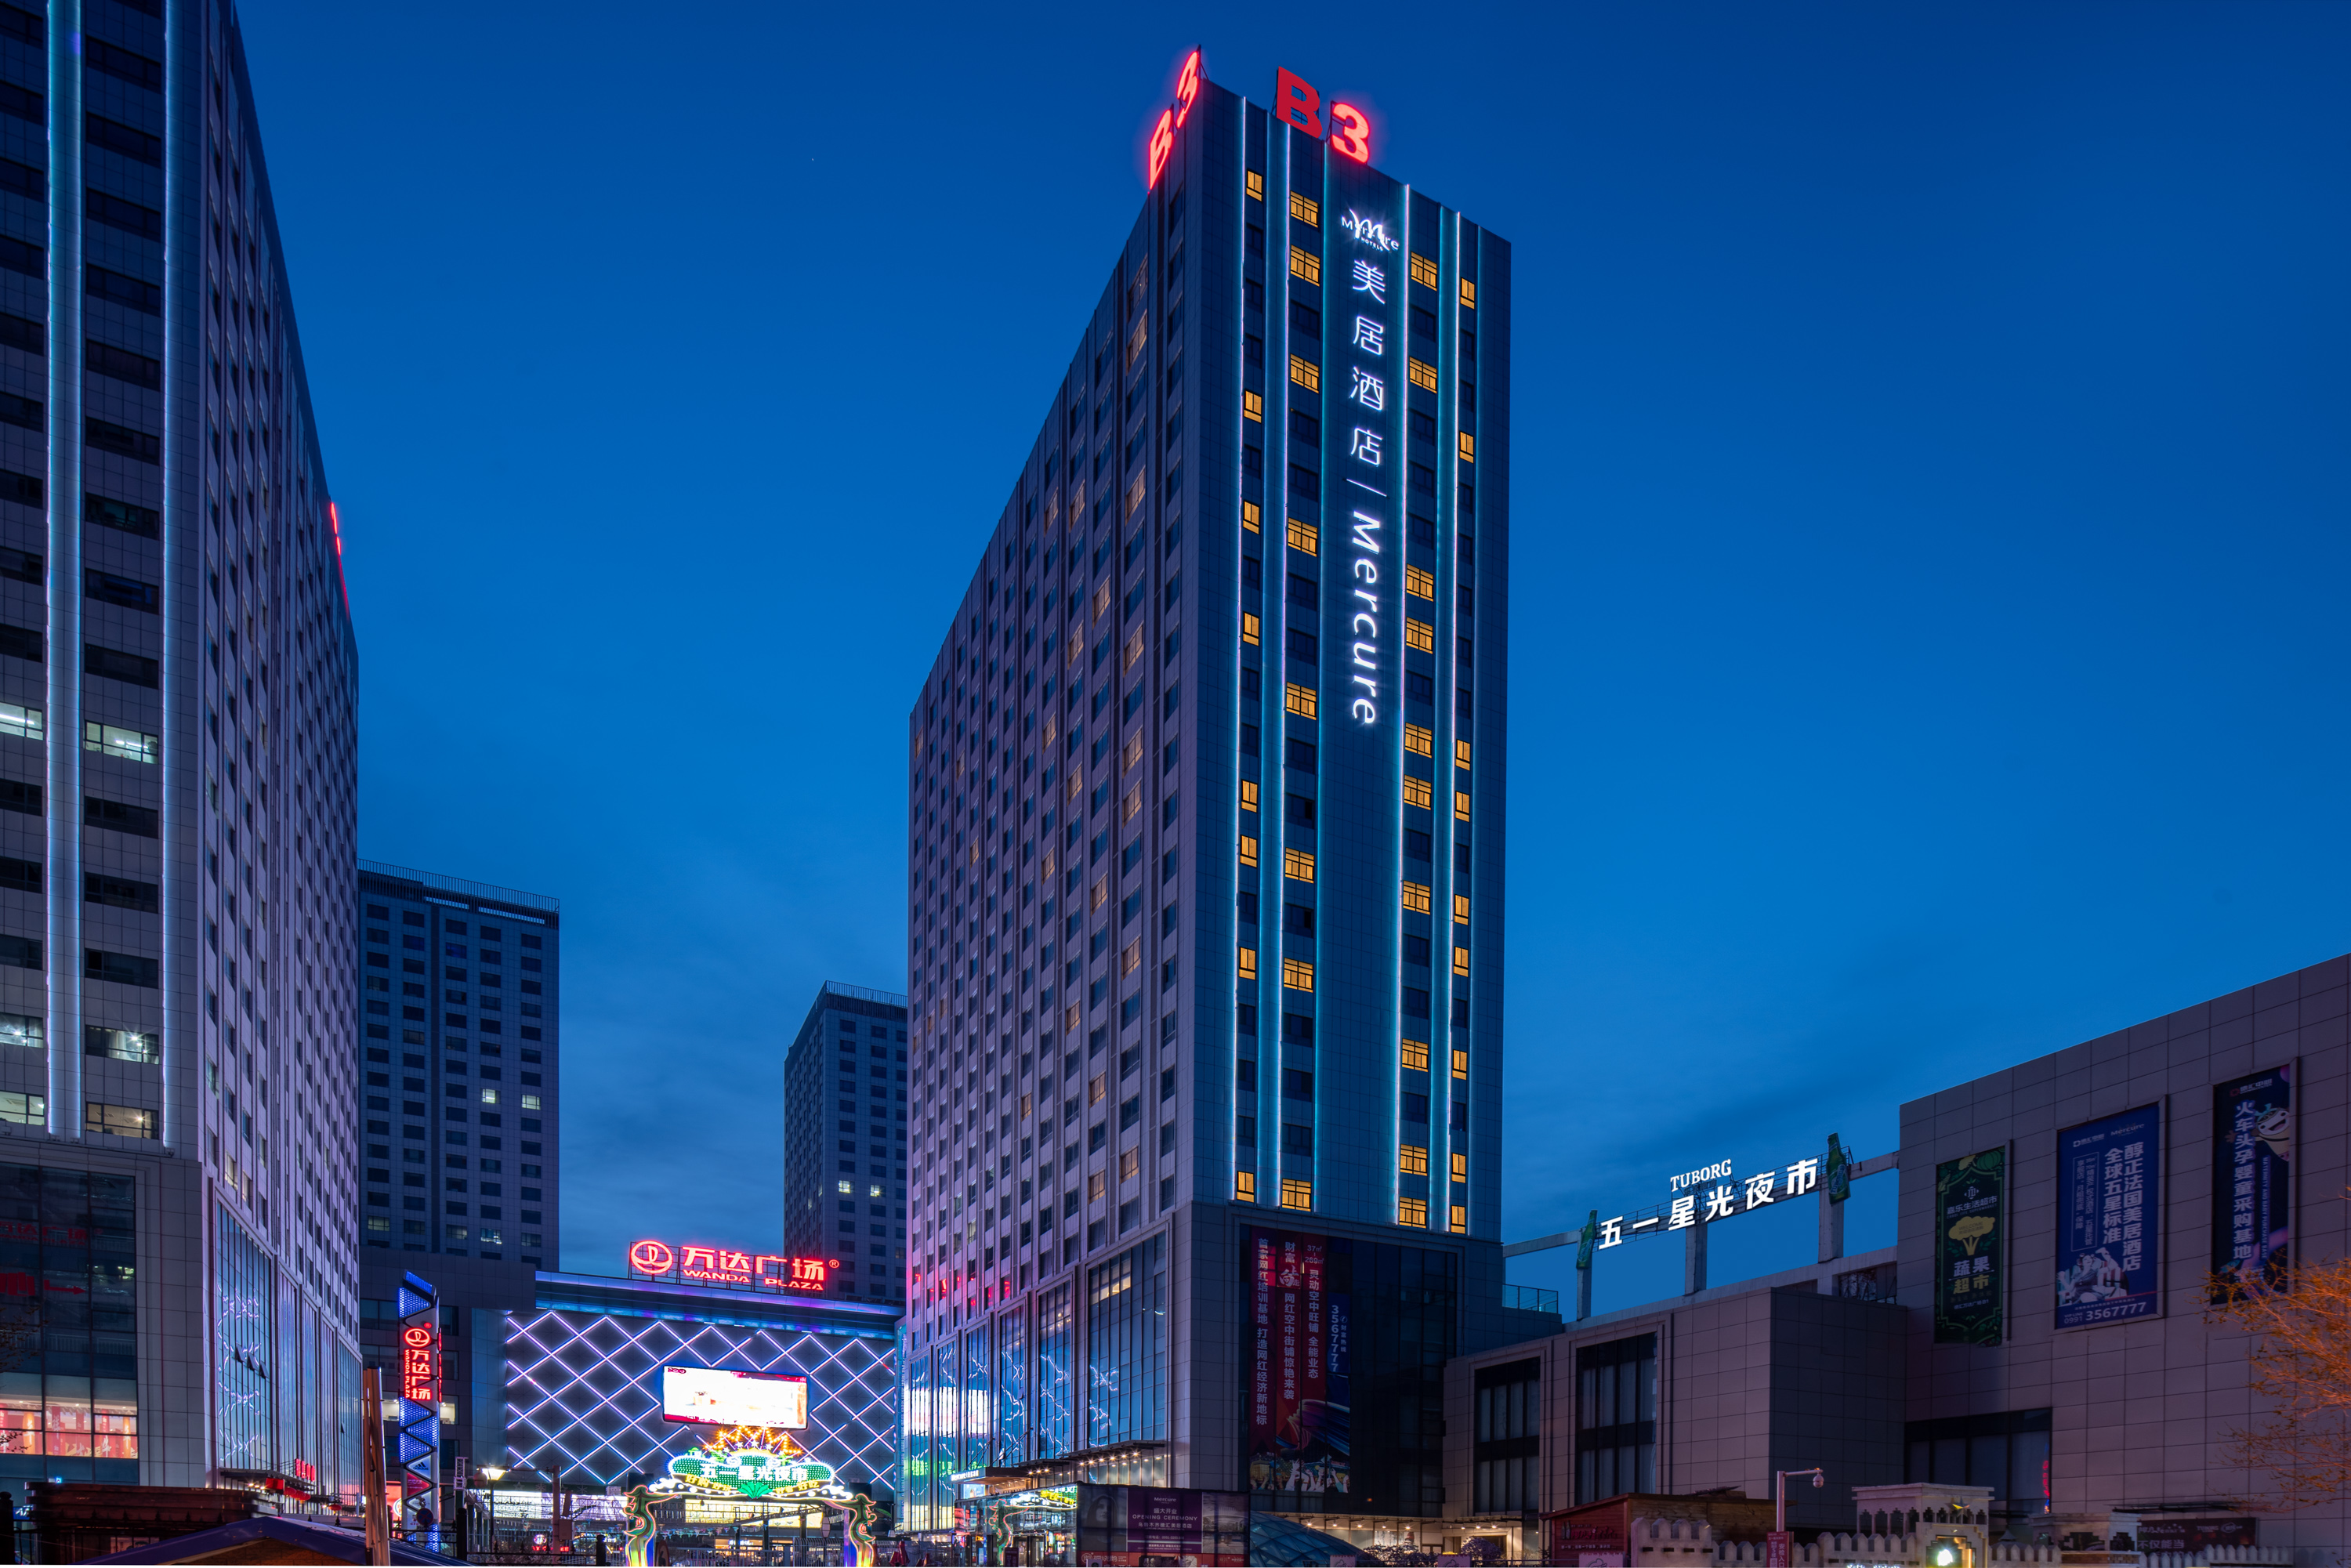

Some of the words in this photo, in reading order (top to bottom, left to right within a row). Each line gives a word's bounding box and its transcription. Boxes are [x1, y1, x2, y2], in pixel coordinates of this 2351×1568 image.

[1149, 51, 1199, 190] B3
[1277, 66, 1371, 165] B3
[1360, 237, 1384, 252] HOTELS
[1349, 260, 1386, 467] 美居酒店
[1352, 510, 1381, 725] Mercure
[2110, 1124, 2145, 1136] Mercure
[1670, 1158, 1732, 1193] TUBORG
[2103, 1147, 2124, 1245] 全球五星标准
[2233, 1101, 2255, 1259] 火车头孕婴童采购基地
[1599, 1158, 1818, 1250] 五一星光夜市
[2122, 1141, 2145, 1272] 醇正法国美居酒店
[682, 1246, 824, 1281] 万达广场
[1284, 1242, 1295, 1264] 财富
[1954, 1255, 1990, 1277] 蔬果
[683, 1269, 751, 1283] WANDA
[764, 1277, 824, 1291] PLAZA
[1257, 1238, 1269, 1325] 首家网红培训基地
[1308, 1269, 1320, 1334] 灵动空中旺铺
[1953, 1274, 1990, 1295] 超市
[2085, 1302, 2147, 1321] 3567777
[1284, 1292, 1295, 1400] 网红空中街铺惊艳来袭
[1308, 1336, 1319, 1379] 全能业态
[1331, 1305, 1339, 1372] 3567777
[411, 1349, 432, 1400] 万达广场
[1256, 1327, 1268, 1425] 打造网红经济新地标
[700, 1462, 808, 1482] 五一星光夜市
[797, 1479, 820, 1491] 好吃
[2137, 1539, 2185, 1549] 不仅能当
